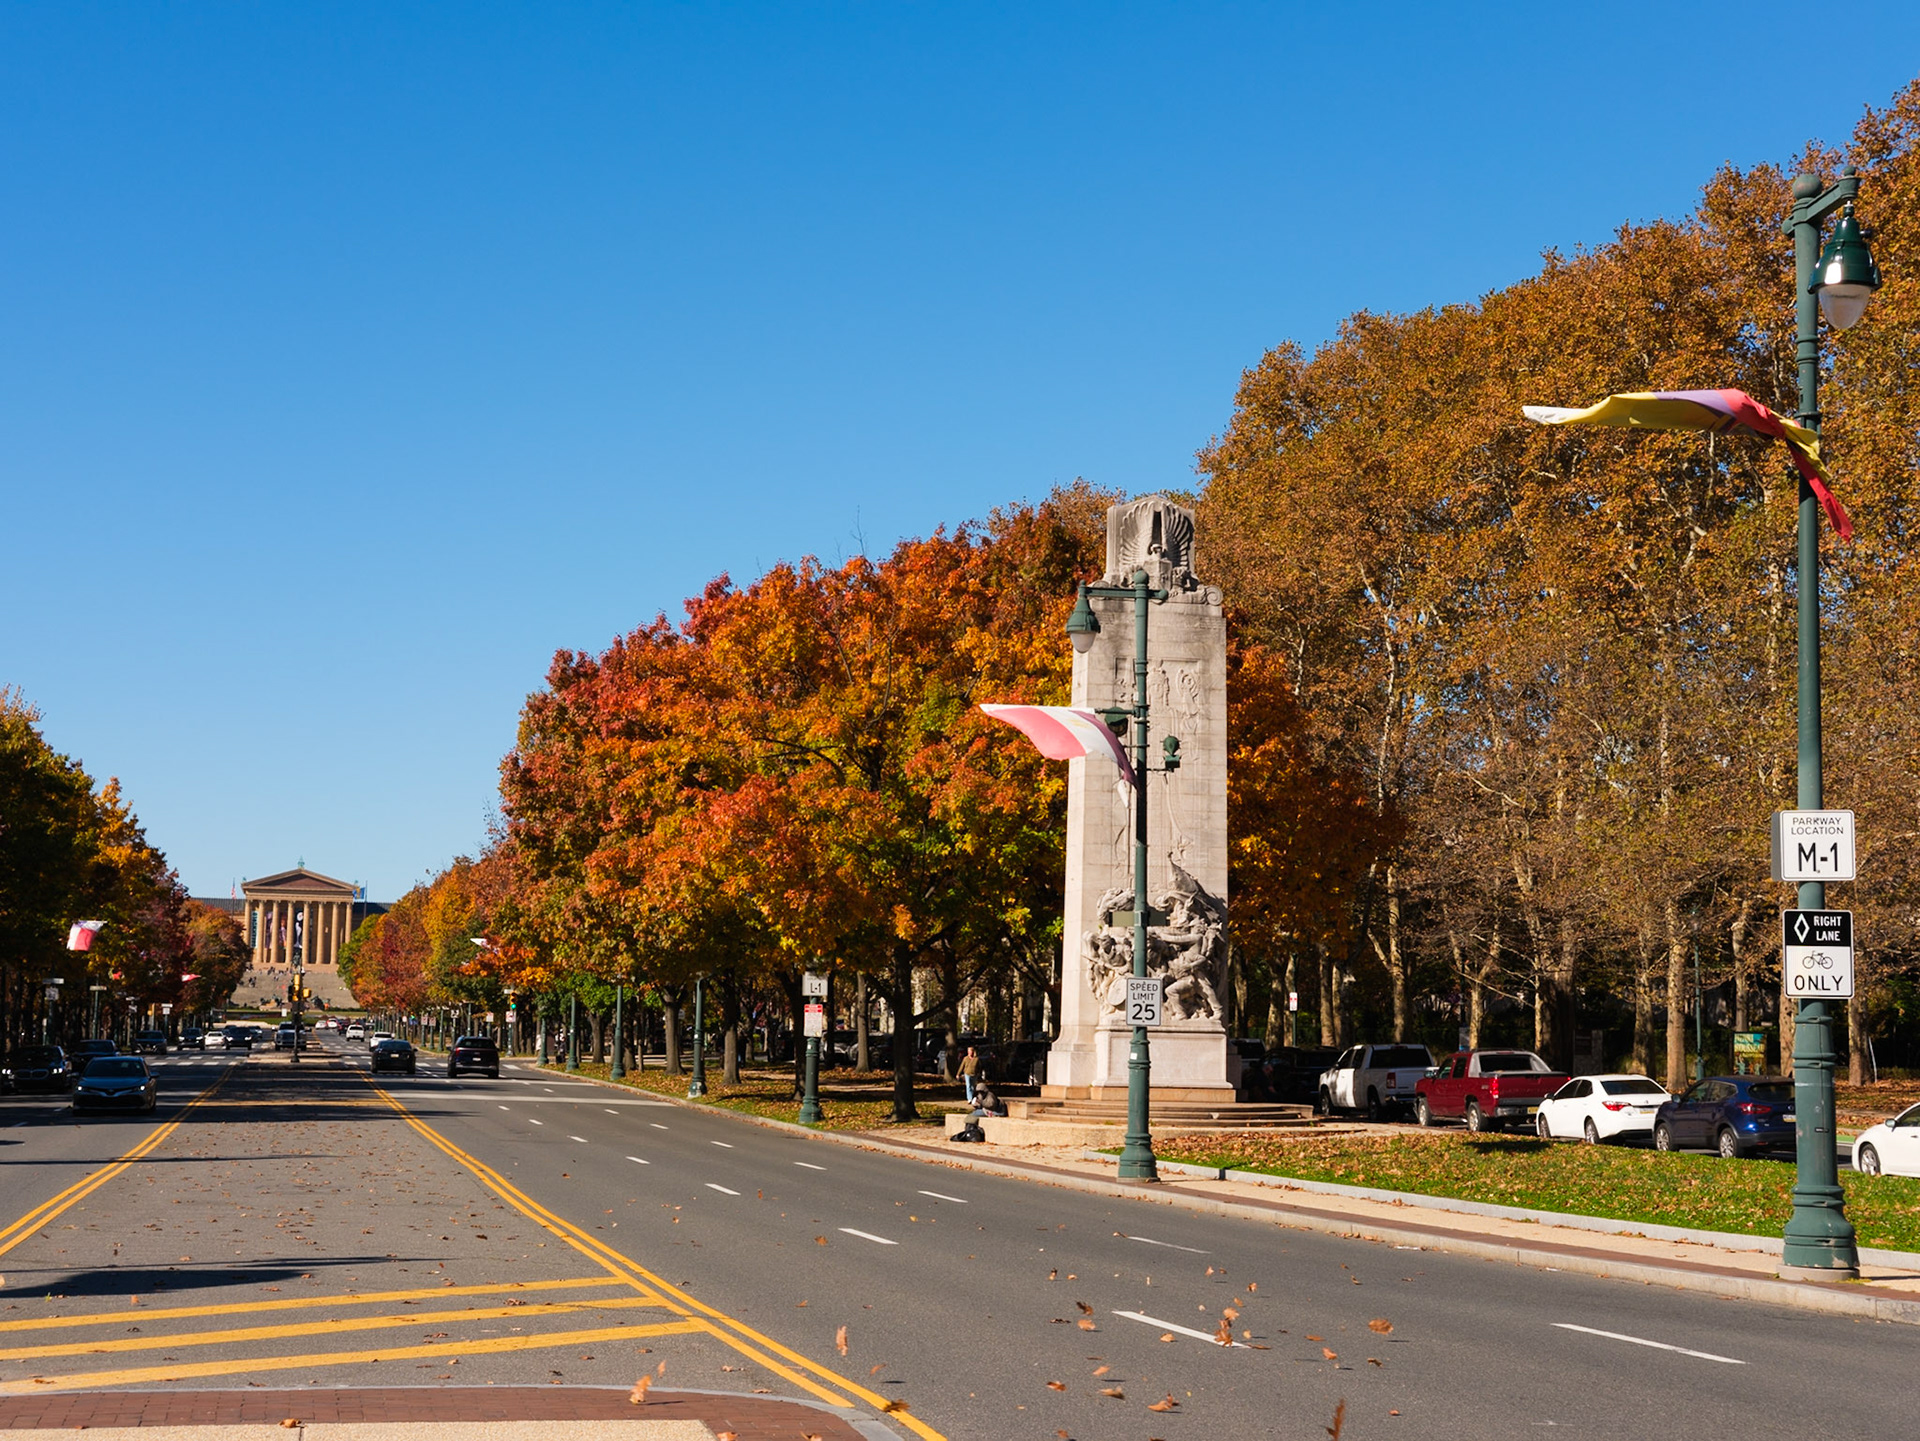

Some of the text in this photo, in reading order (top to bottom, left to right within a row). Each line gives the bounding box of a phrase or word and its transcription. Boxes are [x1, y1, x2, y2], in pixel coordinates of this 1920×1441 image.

[1792, 817, 1842, 826] PARKWAY
[1791, 826, 1844, 835] LOCATION
[1798, 842, 1838, 872] M-1
[1813, 915, 1842, 927] RIGHT
[1816, 930, 1841, 941] LANE
[810, 983, 821, 993] L-1
[1130, 983, 1158, 991] SPEED
[1794, 974, 1843, 991] ONLY
[1132, 1003, 1155, 1020] 25
